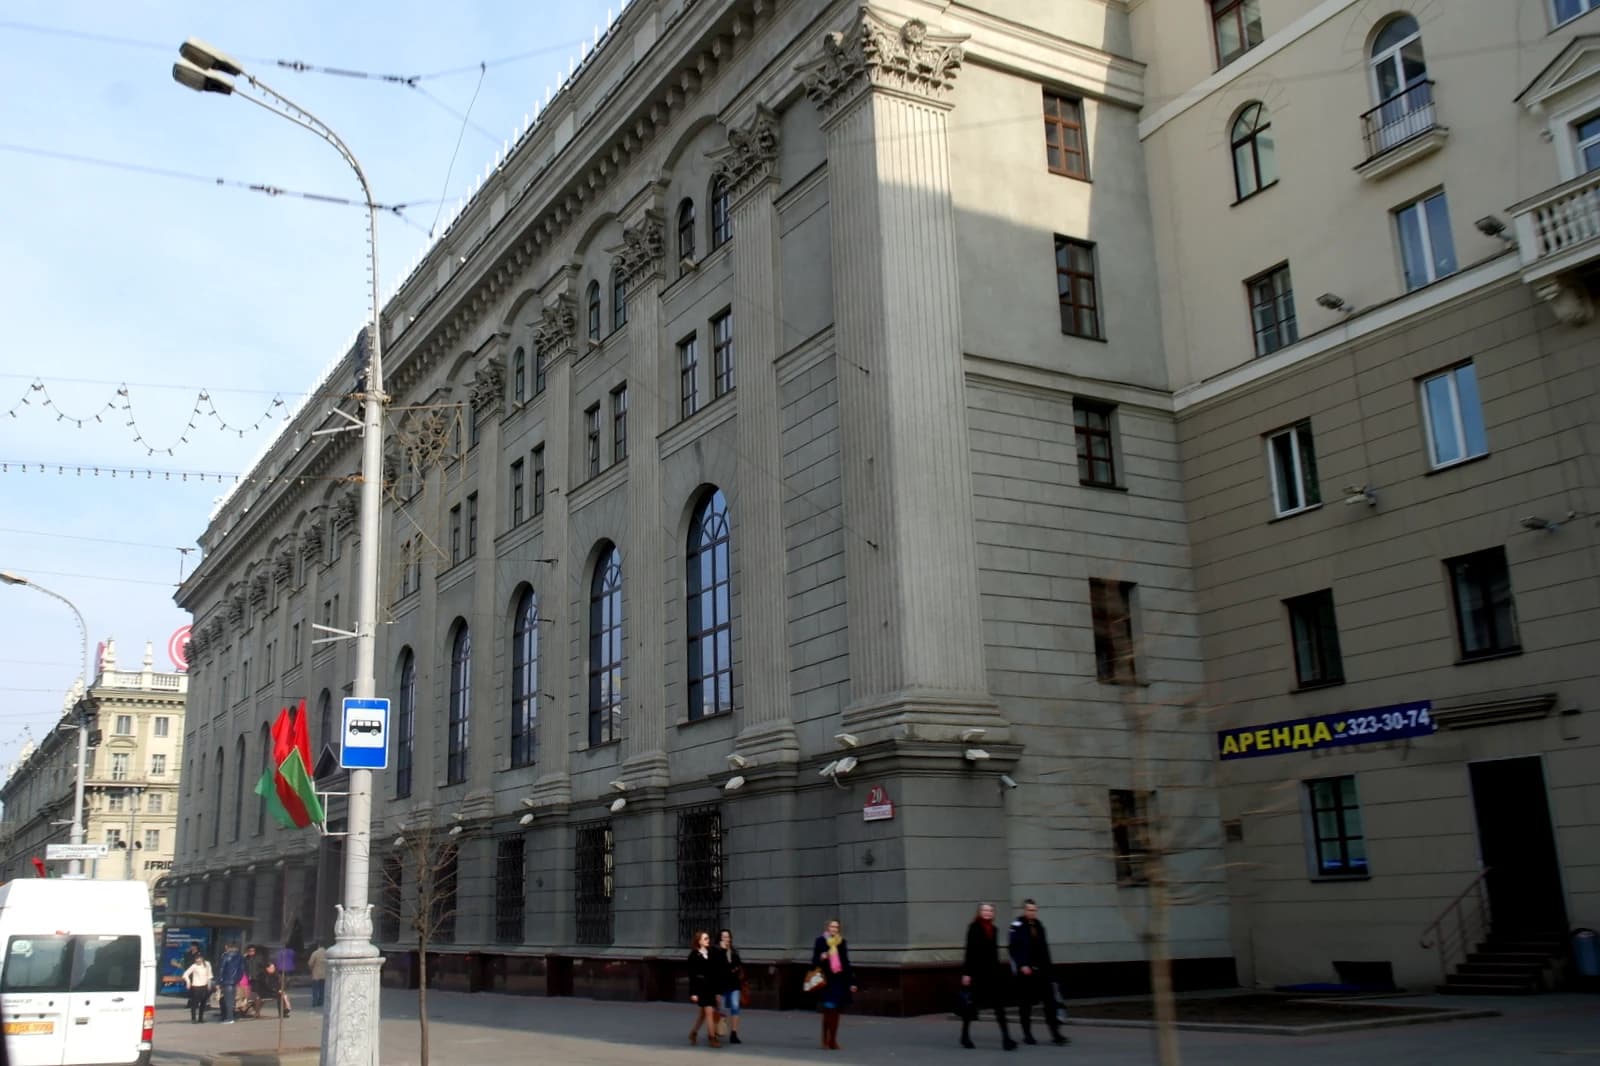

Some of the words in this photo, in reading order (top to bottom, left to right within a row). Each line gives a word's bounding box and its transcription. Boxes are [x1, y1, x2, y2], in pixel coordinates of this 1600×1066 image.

[1222, 721, 1333, 754] АРЕНДА
[1346, 708, 1431, 736] 323-30-74
[871, 788, 882, 803] 20
